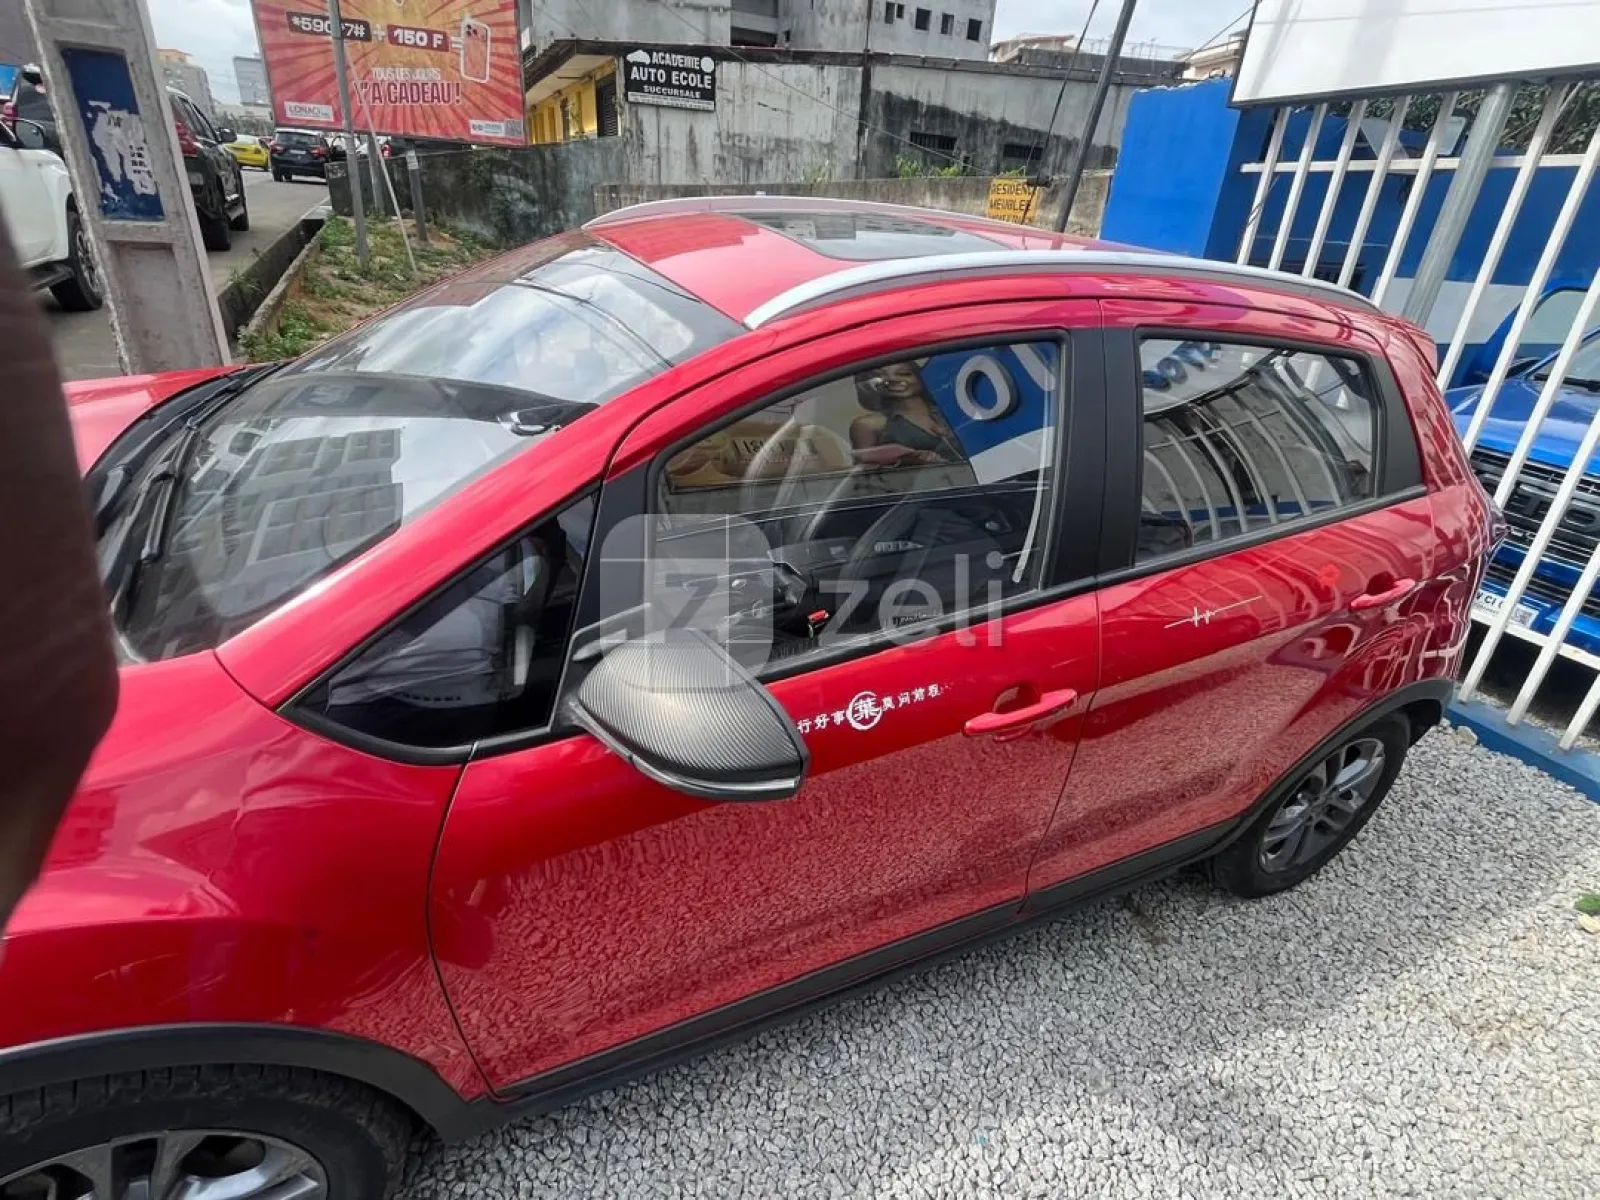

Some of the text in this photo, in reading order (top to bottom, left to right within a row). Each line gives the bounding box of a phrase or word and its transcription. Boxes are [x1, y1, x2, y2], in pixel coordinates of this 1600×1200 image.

[393, 28, 428, 47] 150
[432, 33, 444, 49] F
[630, 66, 712, 89] AUTO ECOLE
[386, 81, 452, 105] CADEAU
[643, 85, 701, 98] SUCCURSALE
